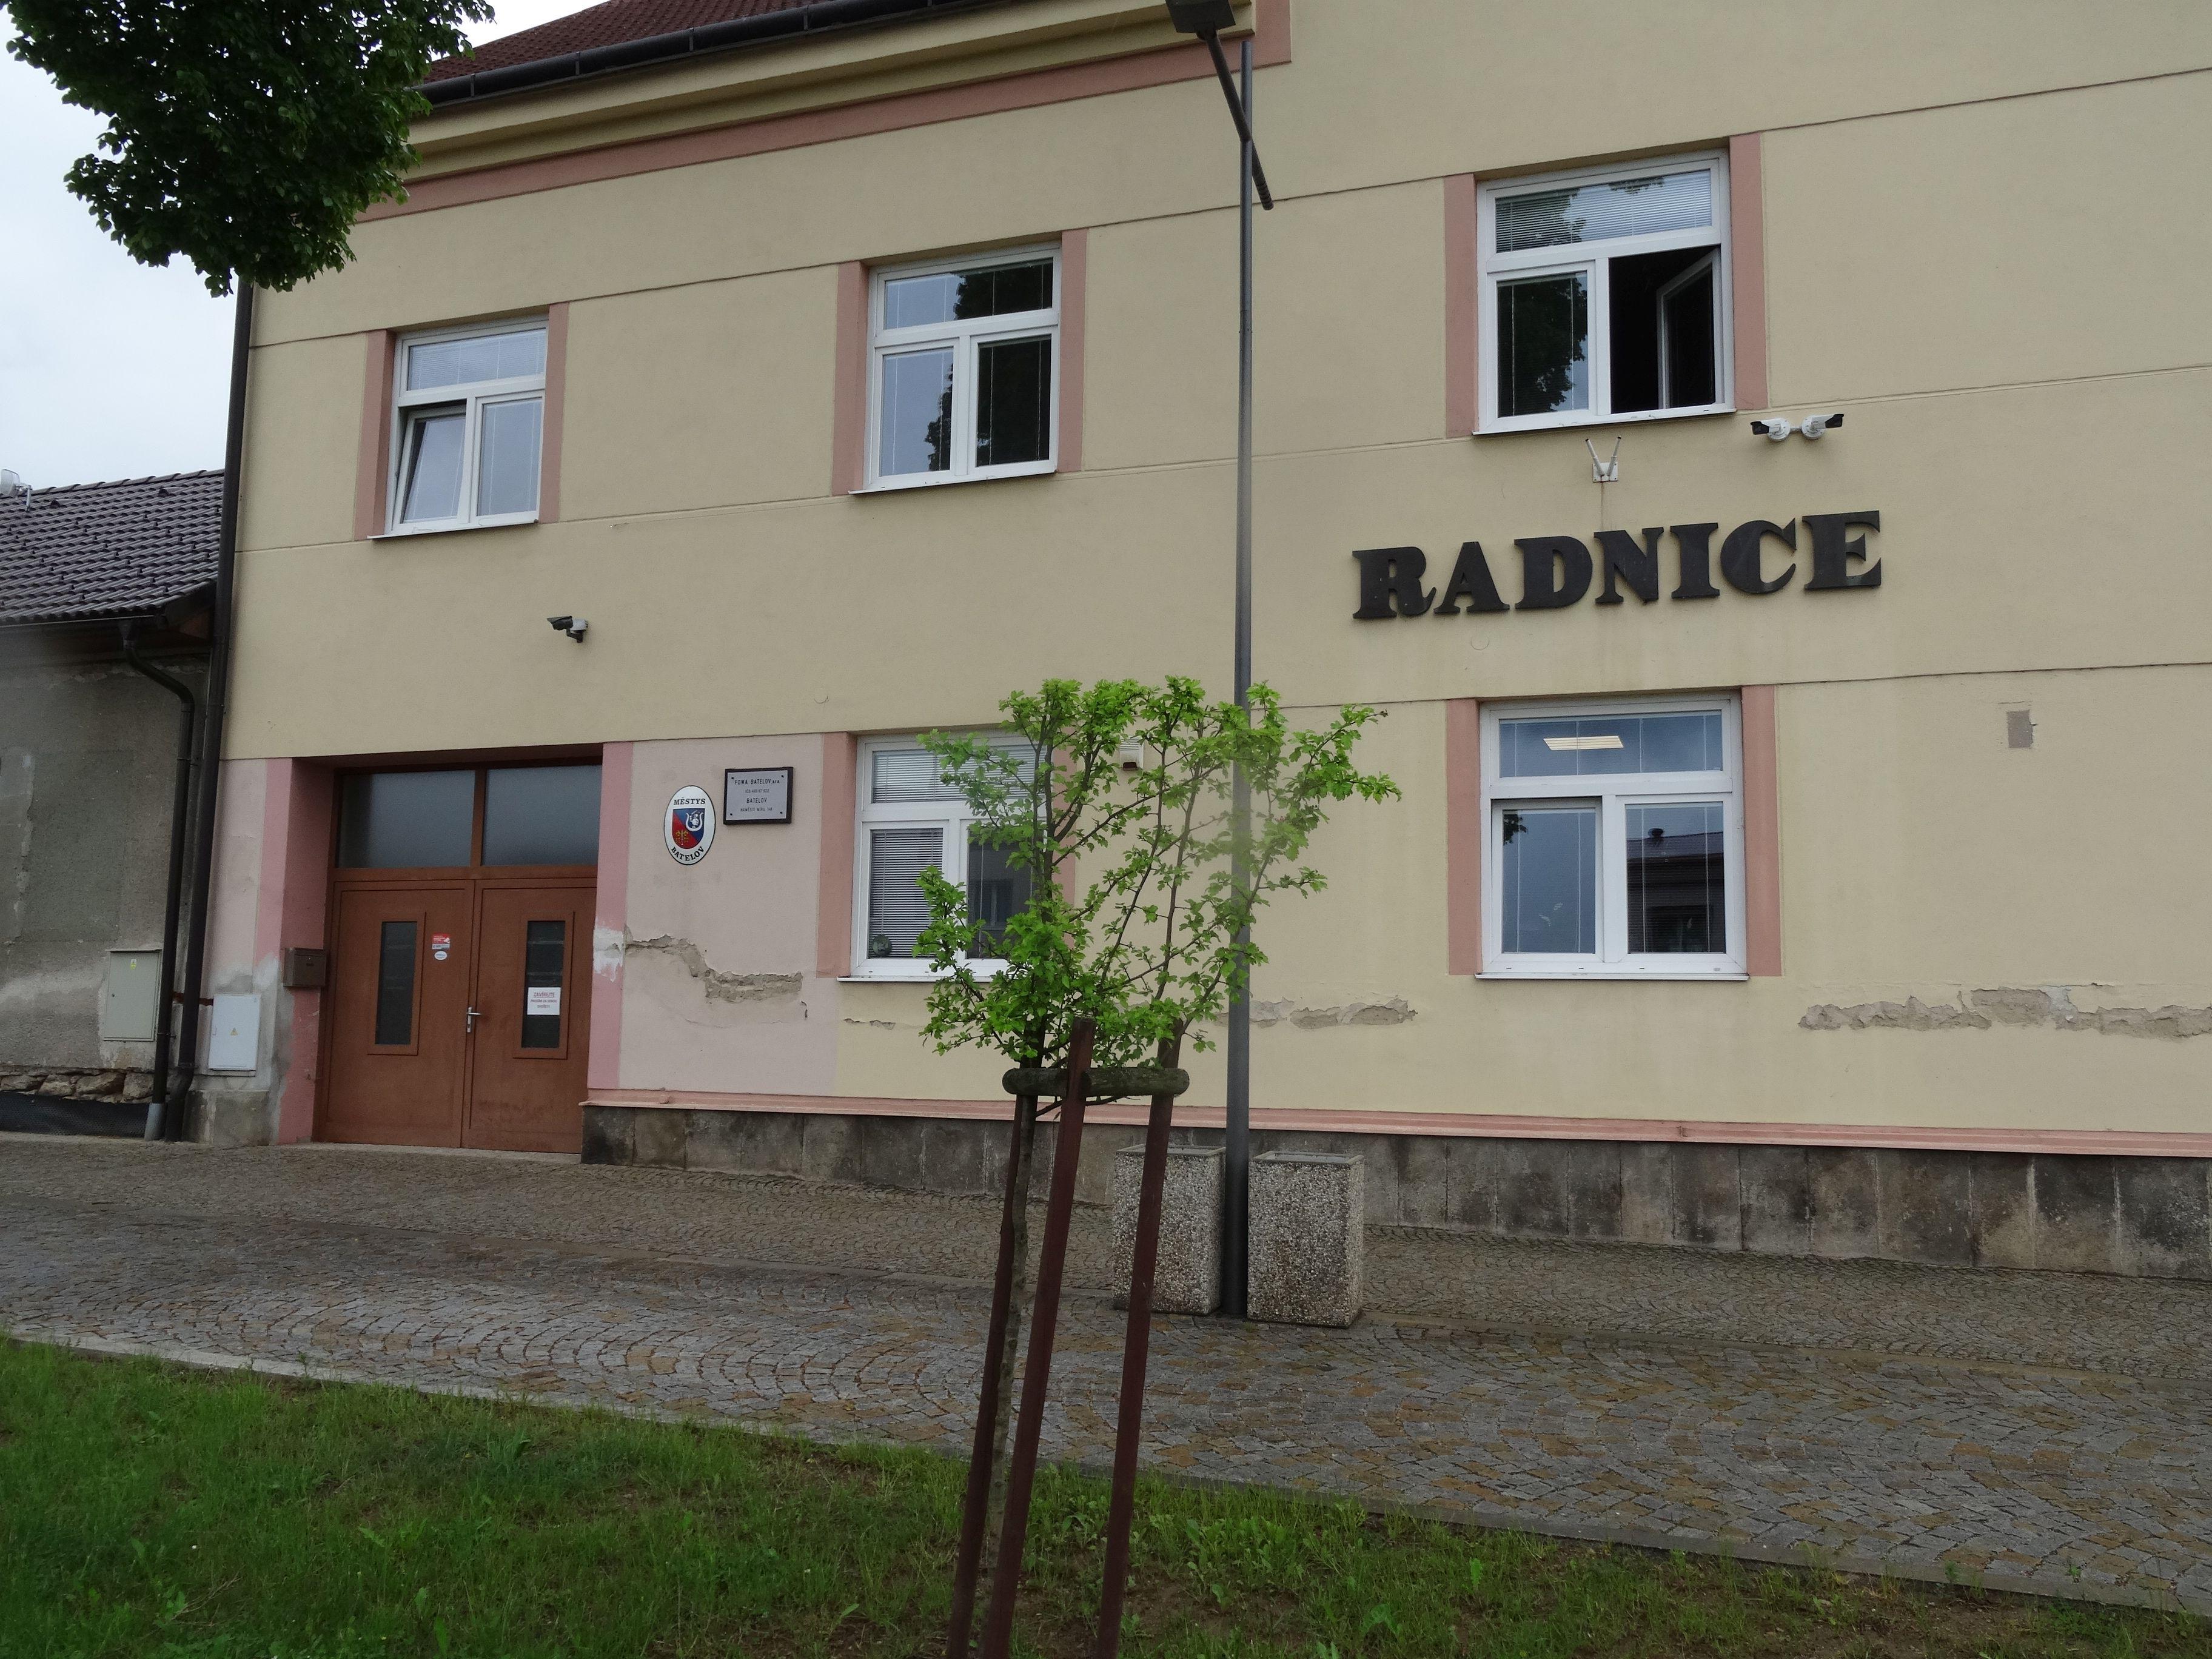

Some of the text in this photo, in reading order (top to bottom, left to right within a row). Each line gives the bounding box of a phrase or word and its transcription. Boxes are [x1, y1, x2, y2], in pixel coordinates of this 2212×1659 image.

[1352, 511, 1882, 619] RADNICE
[674, 797, 706, 805] MĚSTYS
[671, 846, 704, 861] BATELOV
